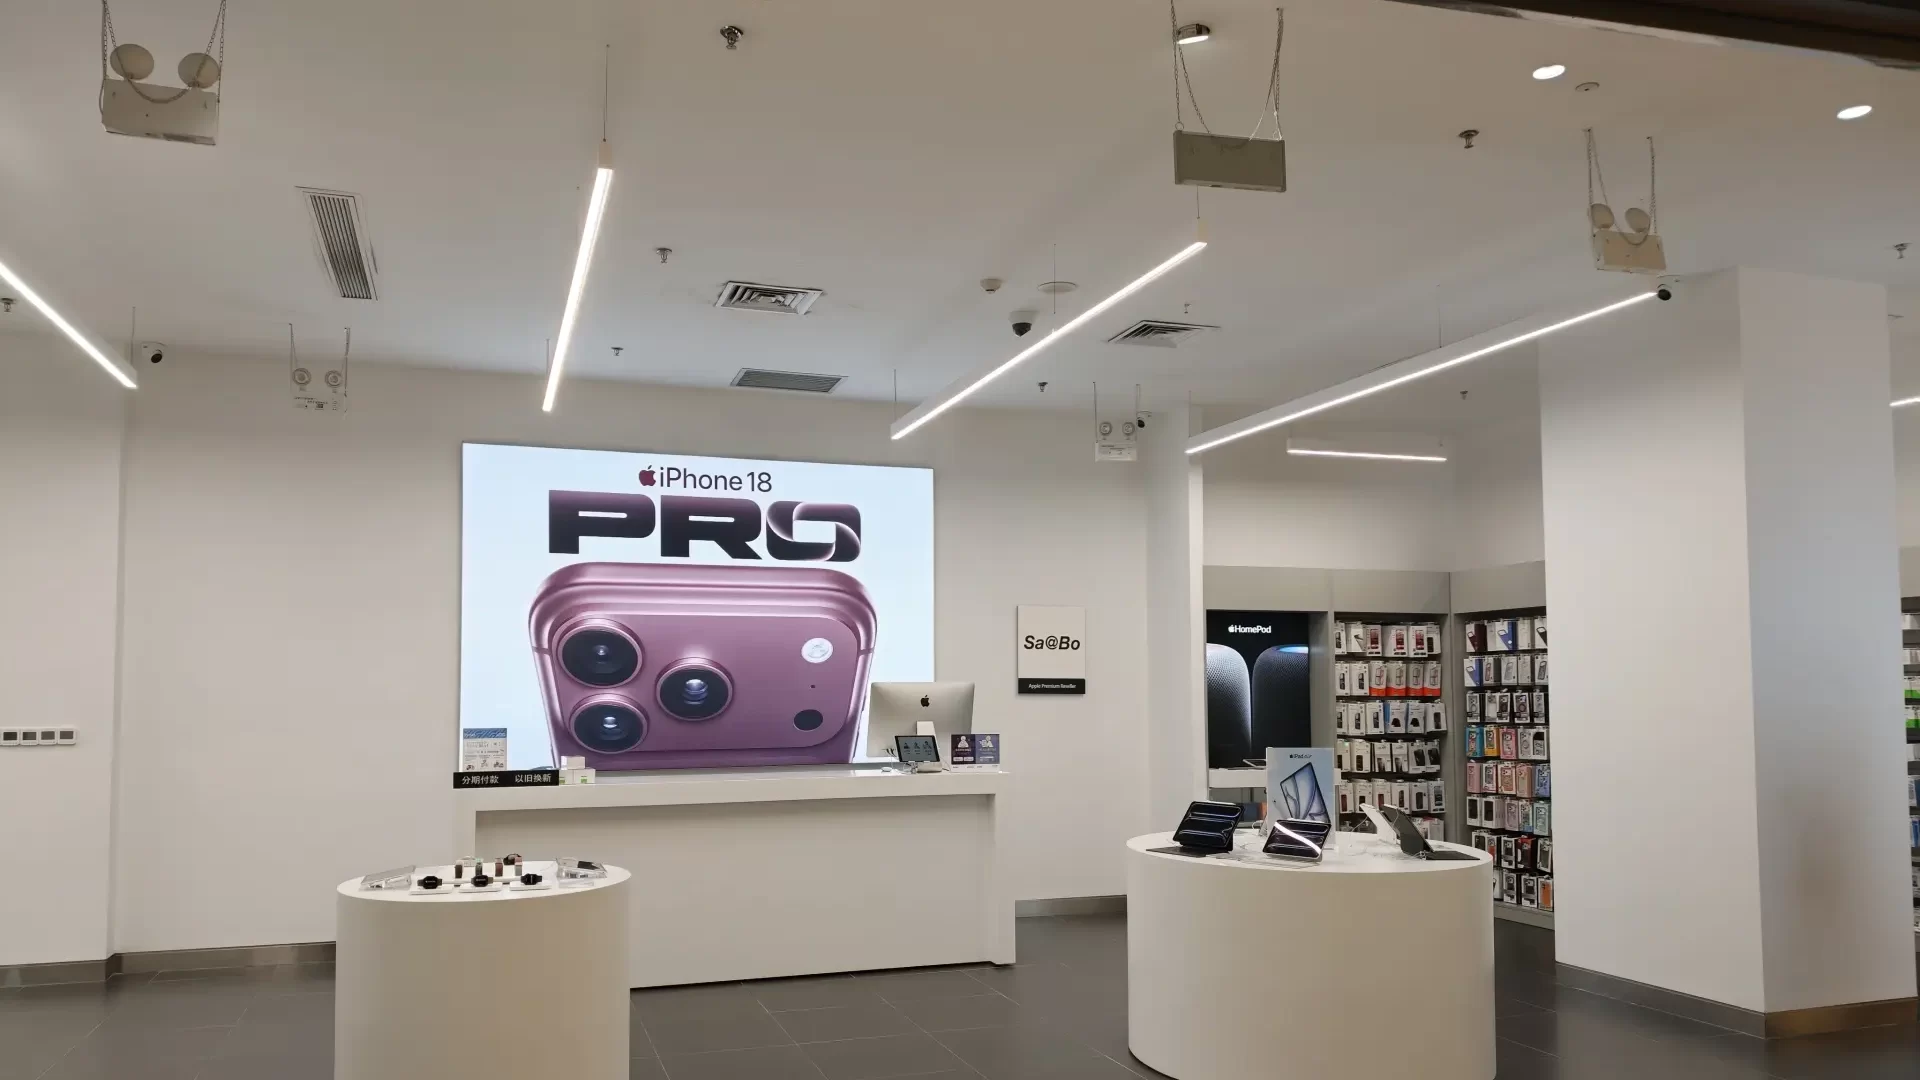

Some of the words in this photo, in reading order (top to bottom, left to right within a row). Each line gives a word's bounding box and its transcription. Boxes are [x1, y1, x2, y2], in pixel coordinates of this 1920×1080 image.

[660, 466, 743, 491] iPhone
[747, 471, 772, 493] 18
[548, 490, 862, 562] PRO
[1234, 625, 1272, 634] HomePod
[1023, 635, 1081, 650] Sa@Bo
[461, 775, 499, 785] 分期付款
[514, 773, 552, 784] 以旧换新
